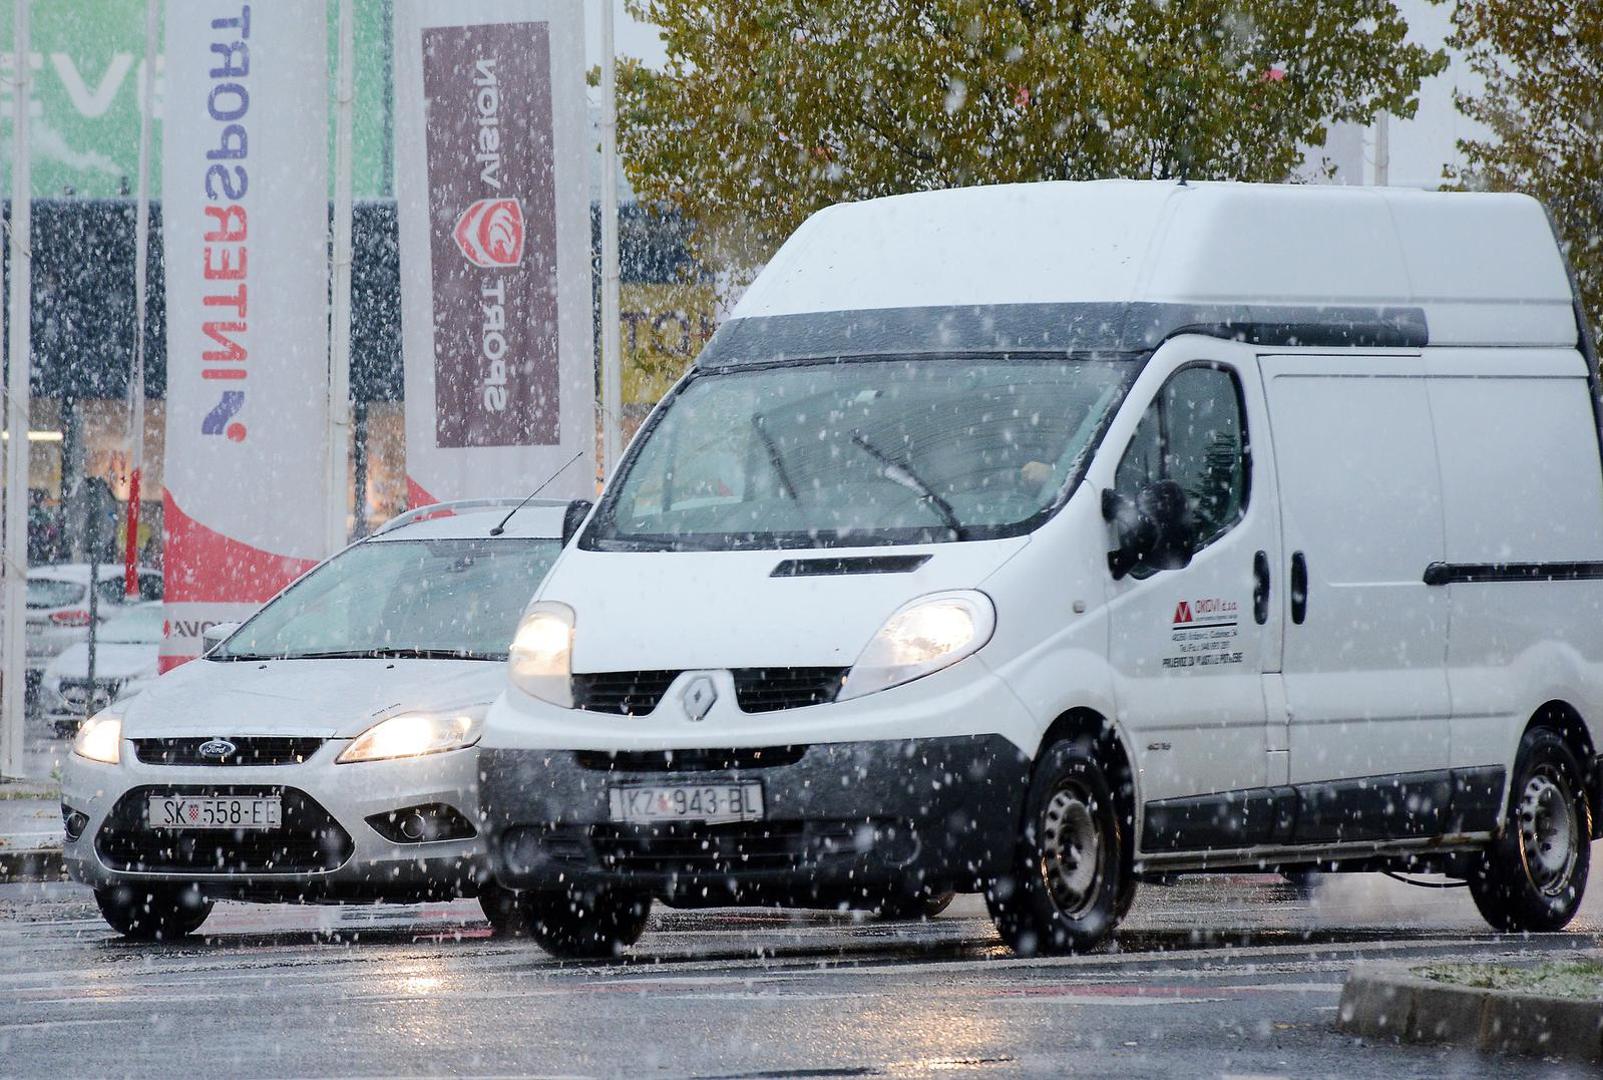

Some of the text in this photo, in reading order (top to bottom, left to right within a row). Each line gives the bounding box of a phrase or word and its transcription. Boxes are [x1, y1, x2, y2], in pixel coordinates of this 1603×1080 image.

[163, 800, 276, 824] SK 558-EE
[627, 788, 656, 816] KZ
